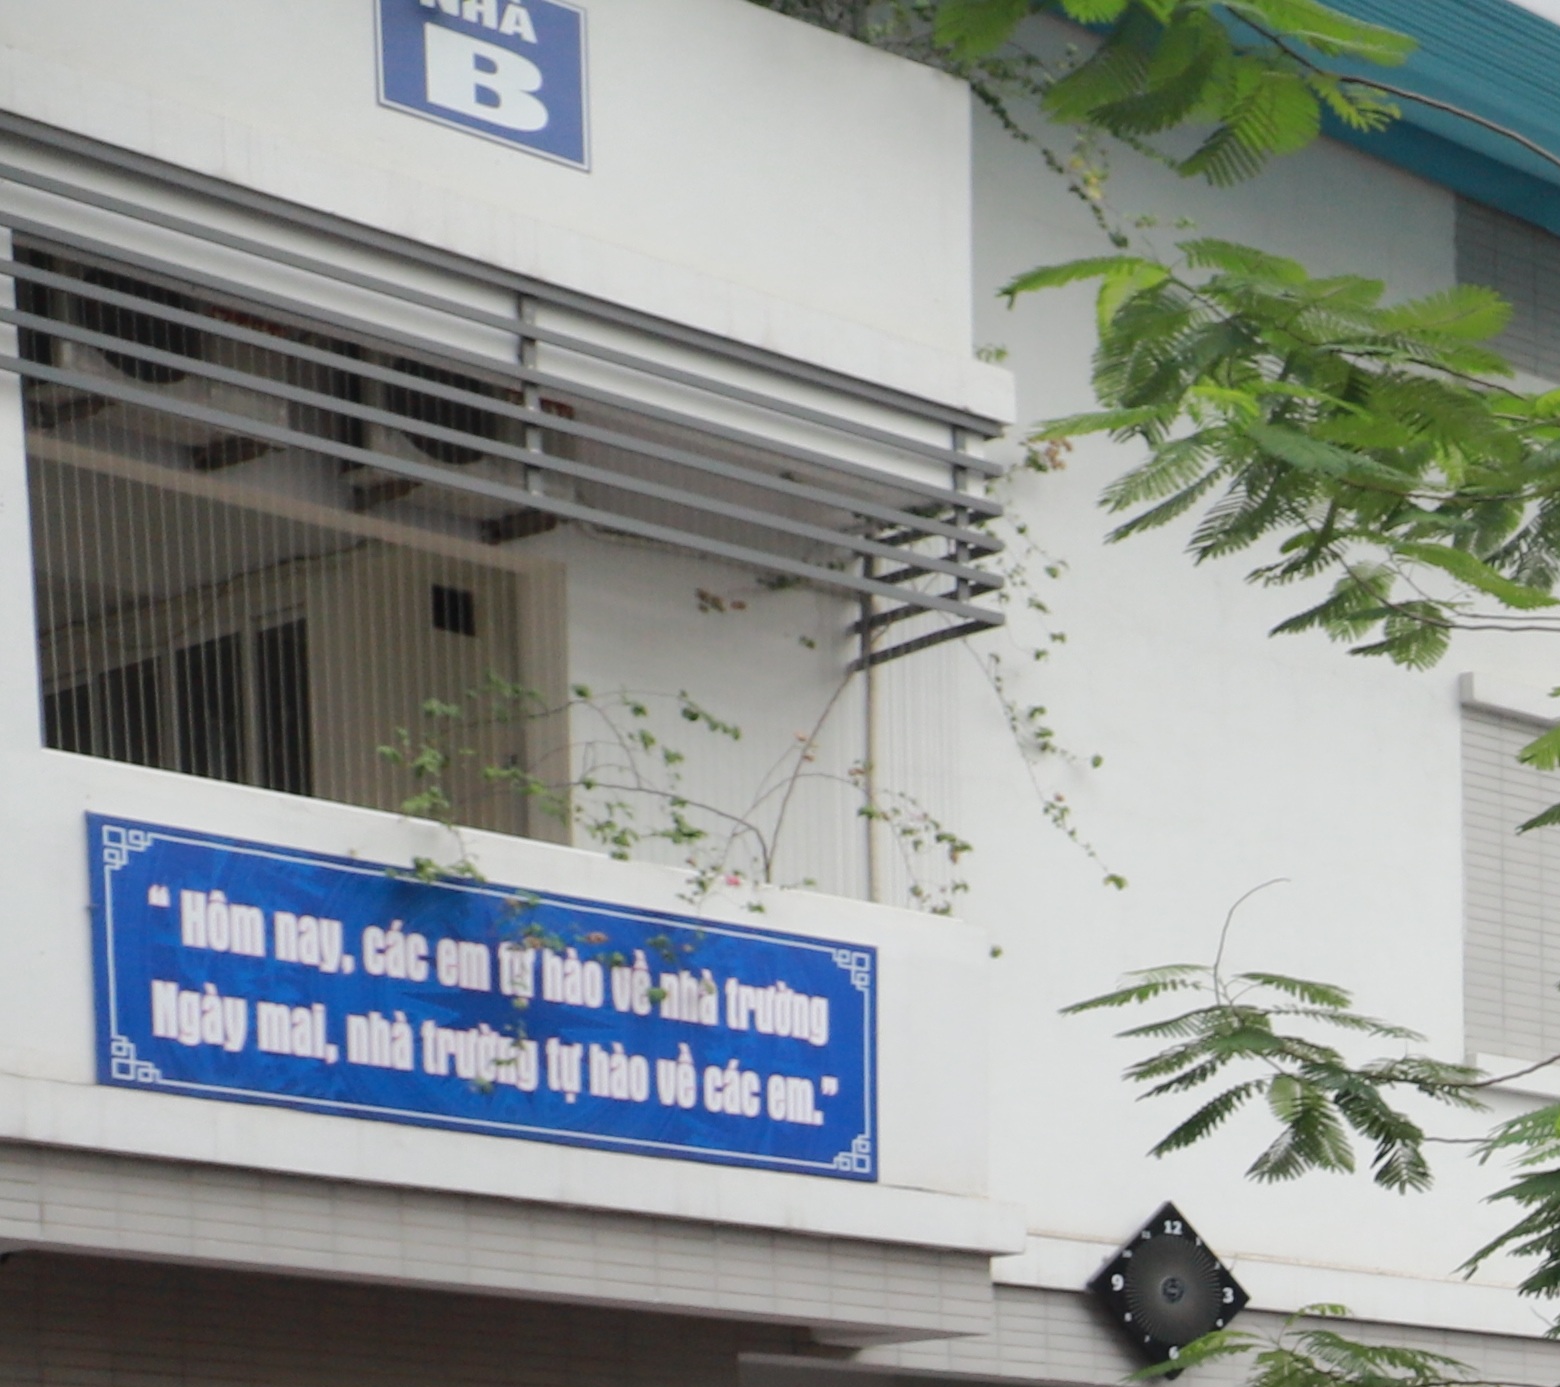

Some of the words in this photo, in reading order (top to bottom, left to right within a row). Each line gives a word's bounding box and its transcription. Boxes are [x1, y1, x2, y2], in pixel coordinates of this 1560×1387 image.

[425, 22, 548, 131] B
[180, 887, 265, 957] Hôm
[274, 909, 355, 975] nay,
[363, 917, 428, 982] các
[436, 936, 492, 992] em
[542, 945, 605, 1009] hào
[610, 948, 652, 1016] về
[660, 967, 718, 1027] nhà
[725, 975, 830, 1047] trường
[151, 977, 248, 1052] Ngày
[256, 1000, 340, 1064] mai,
[346, 1008, 414, 1072] nhà
[546, 1035, 583, 1104] tự
[588, 1039, 649, 1103] hào
[655, 1040, 697, 1110] về
[702, 1057, 762, 1118] các
